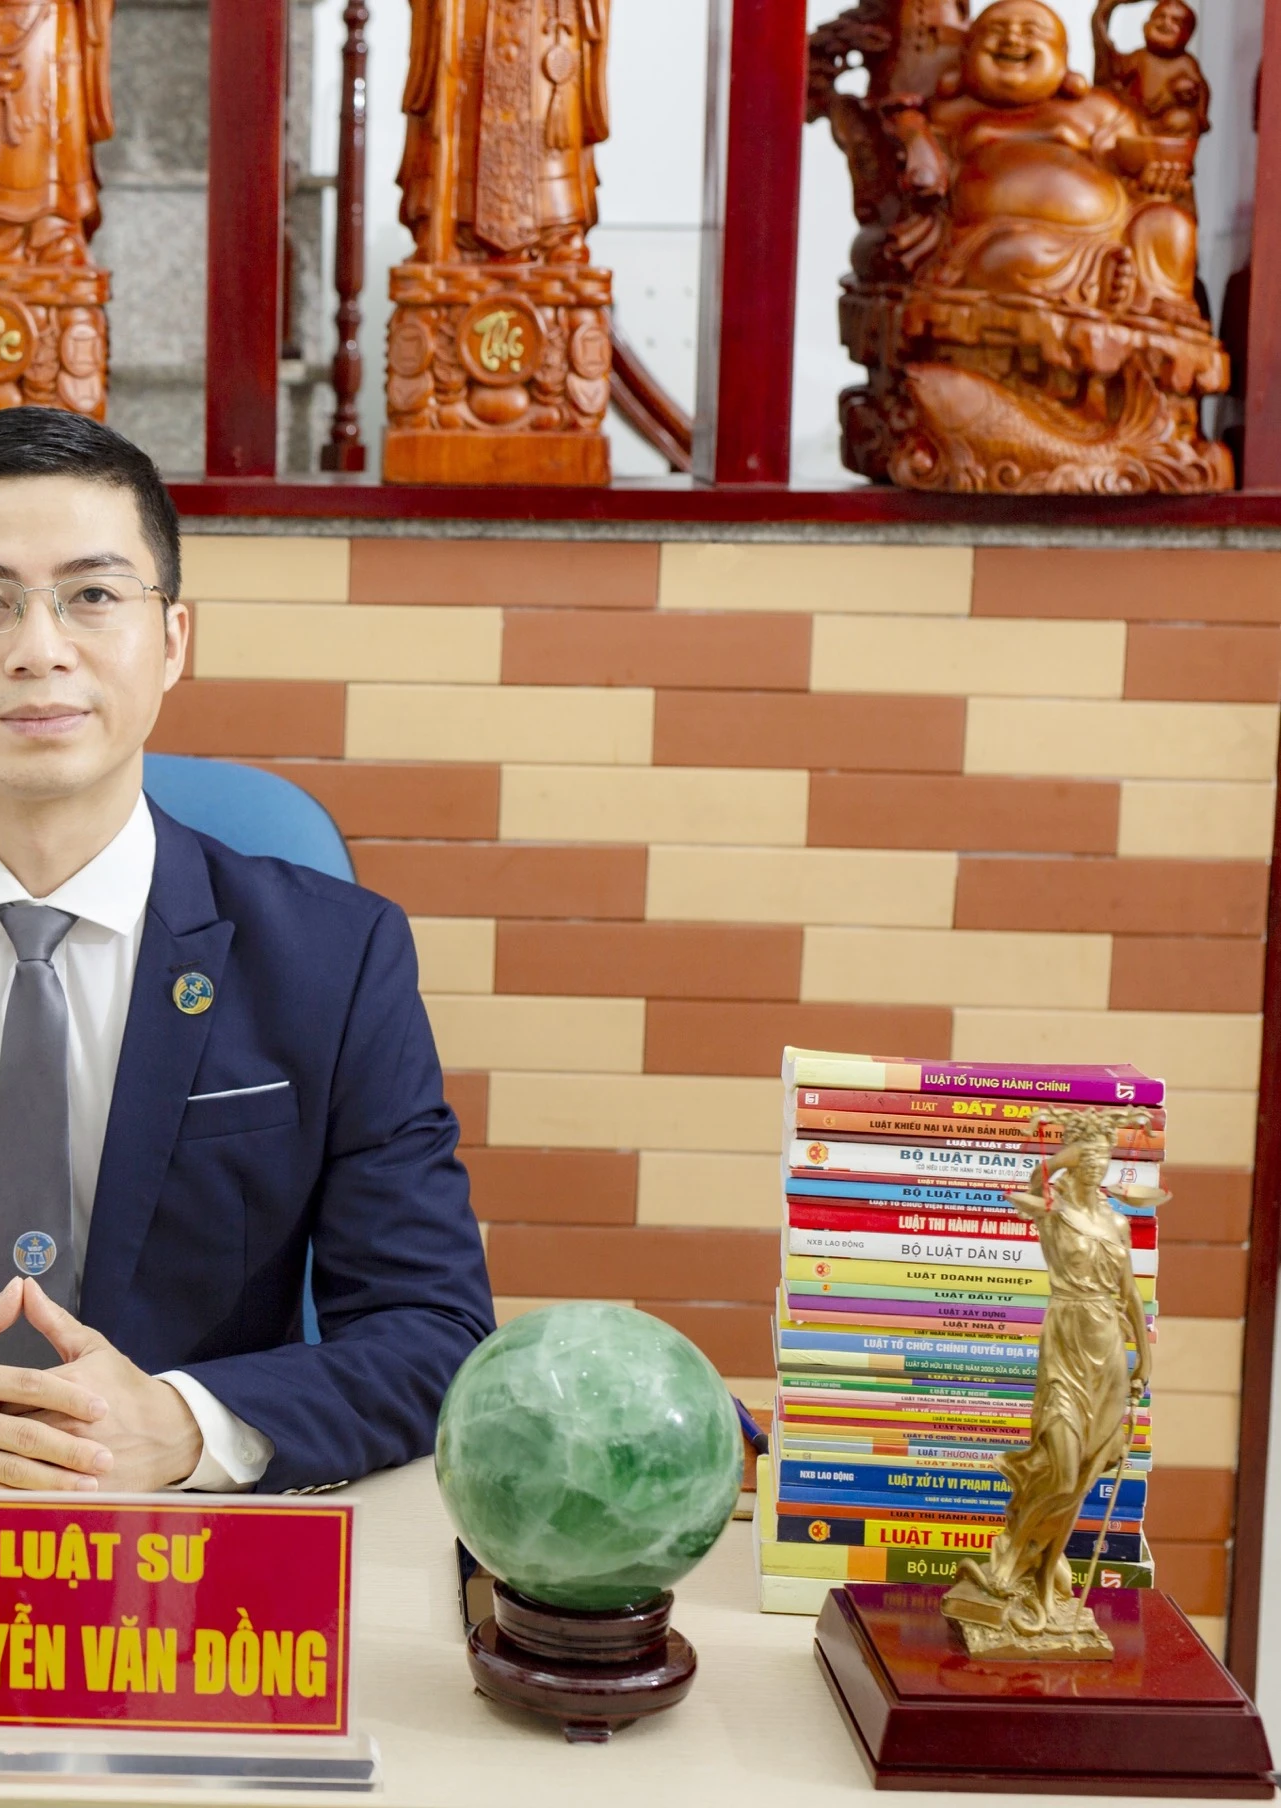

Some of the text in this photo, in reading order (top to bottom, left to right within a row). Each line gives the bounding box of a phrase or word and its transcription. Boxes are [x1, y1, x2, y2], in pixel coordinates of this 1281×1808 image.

[925, 1075, 1070, 1092] LUẬT TỐ TỤNG HÀNH CHÍNH
[952, 1100, 996, 1116] ĐẤT
[900, 1150, 1016, 1167] BỘ LUẬT DÂN
[903, 1188, 992, 1200] BỘ LUẬT LAO
[899, 1215, 1026, 1236] LUẬT THI HÀNH ÁN HÌNH
[902, 1244, 1022, 1263] BỘ LUẬT DÂN SỰ
[907, 1272, 1032, 1285] LUẬT DOANH NGHIỆP
[800, 1471, 854, 1482] NXB LAO ĐỘNG
[888, 1474, 991, 1492] LUẬT XỬ LÝ VI PHẠM
[880, 1526, 932, 1548] LUẬT
[0, 1523, 211, 1588] LUẬT SƯ
[907, 1560, 957, 1578] BỘ LUẬ
[81, 1615, 177, 1694] VĂN
[194, 1607, 327, 1697] ĐỒNG
